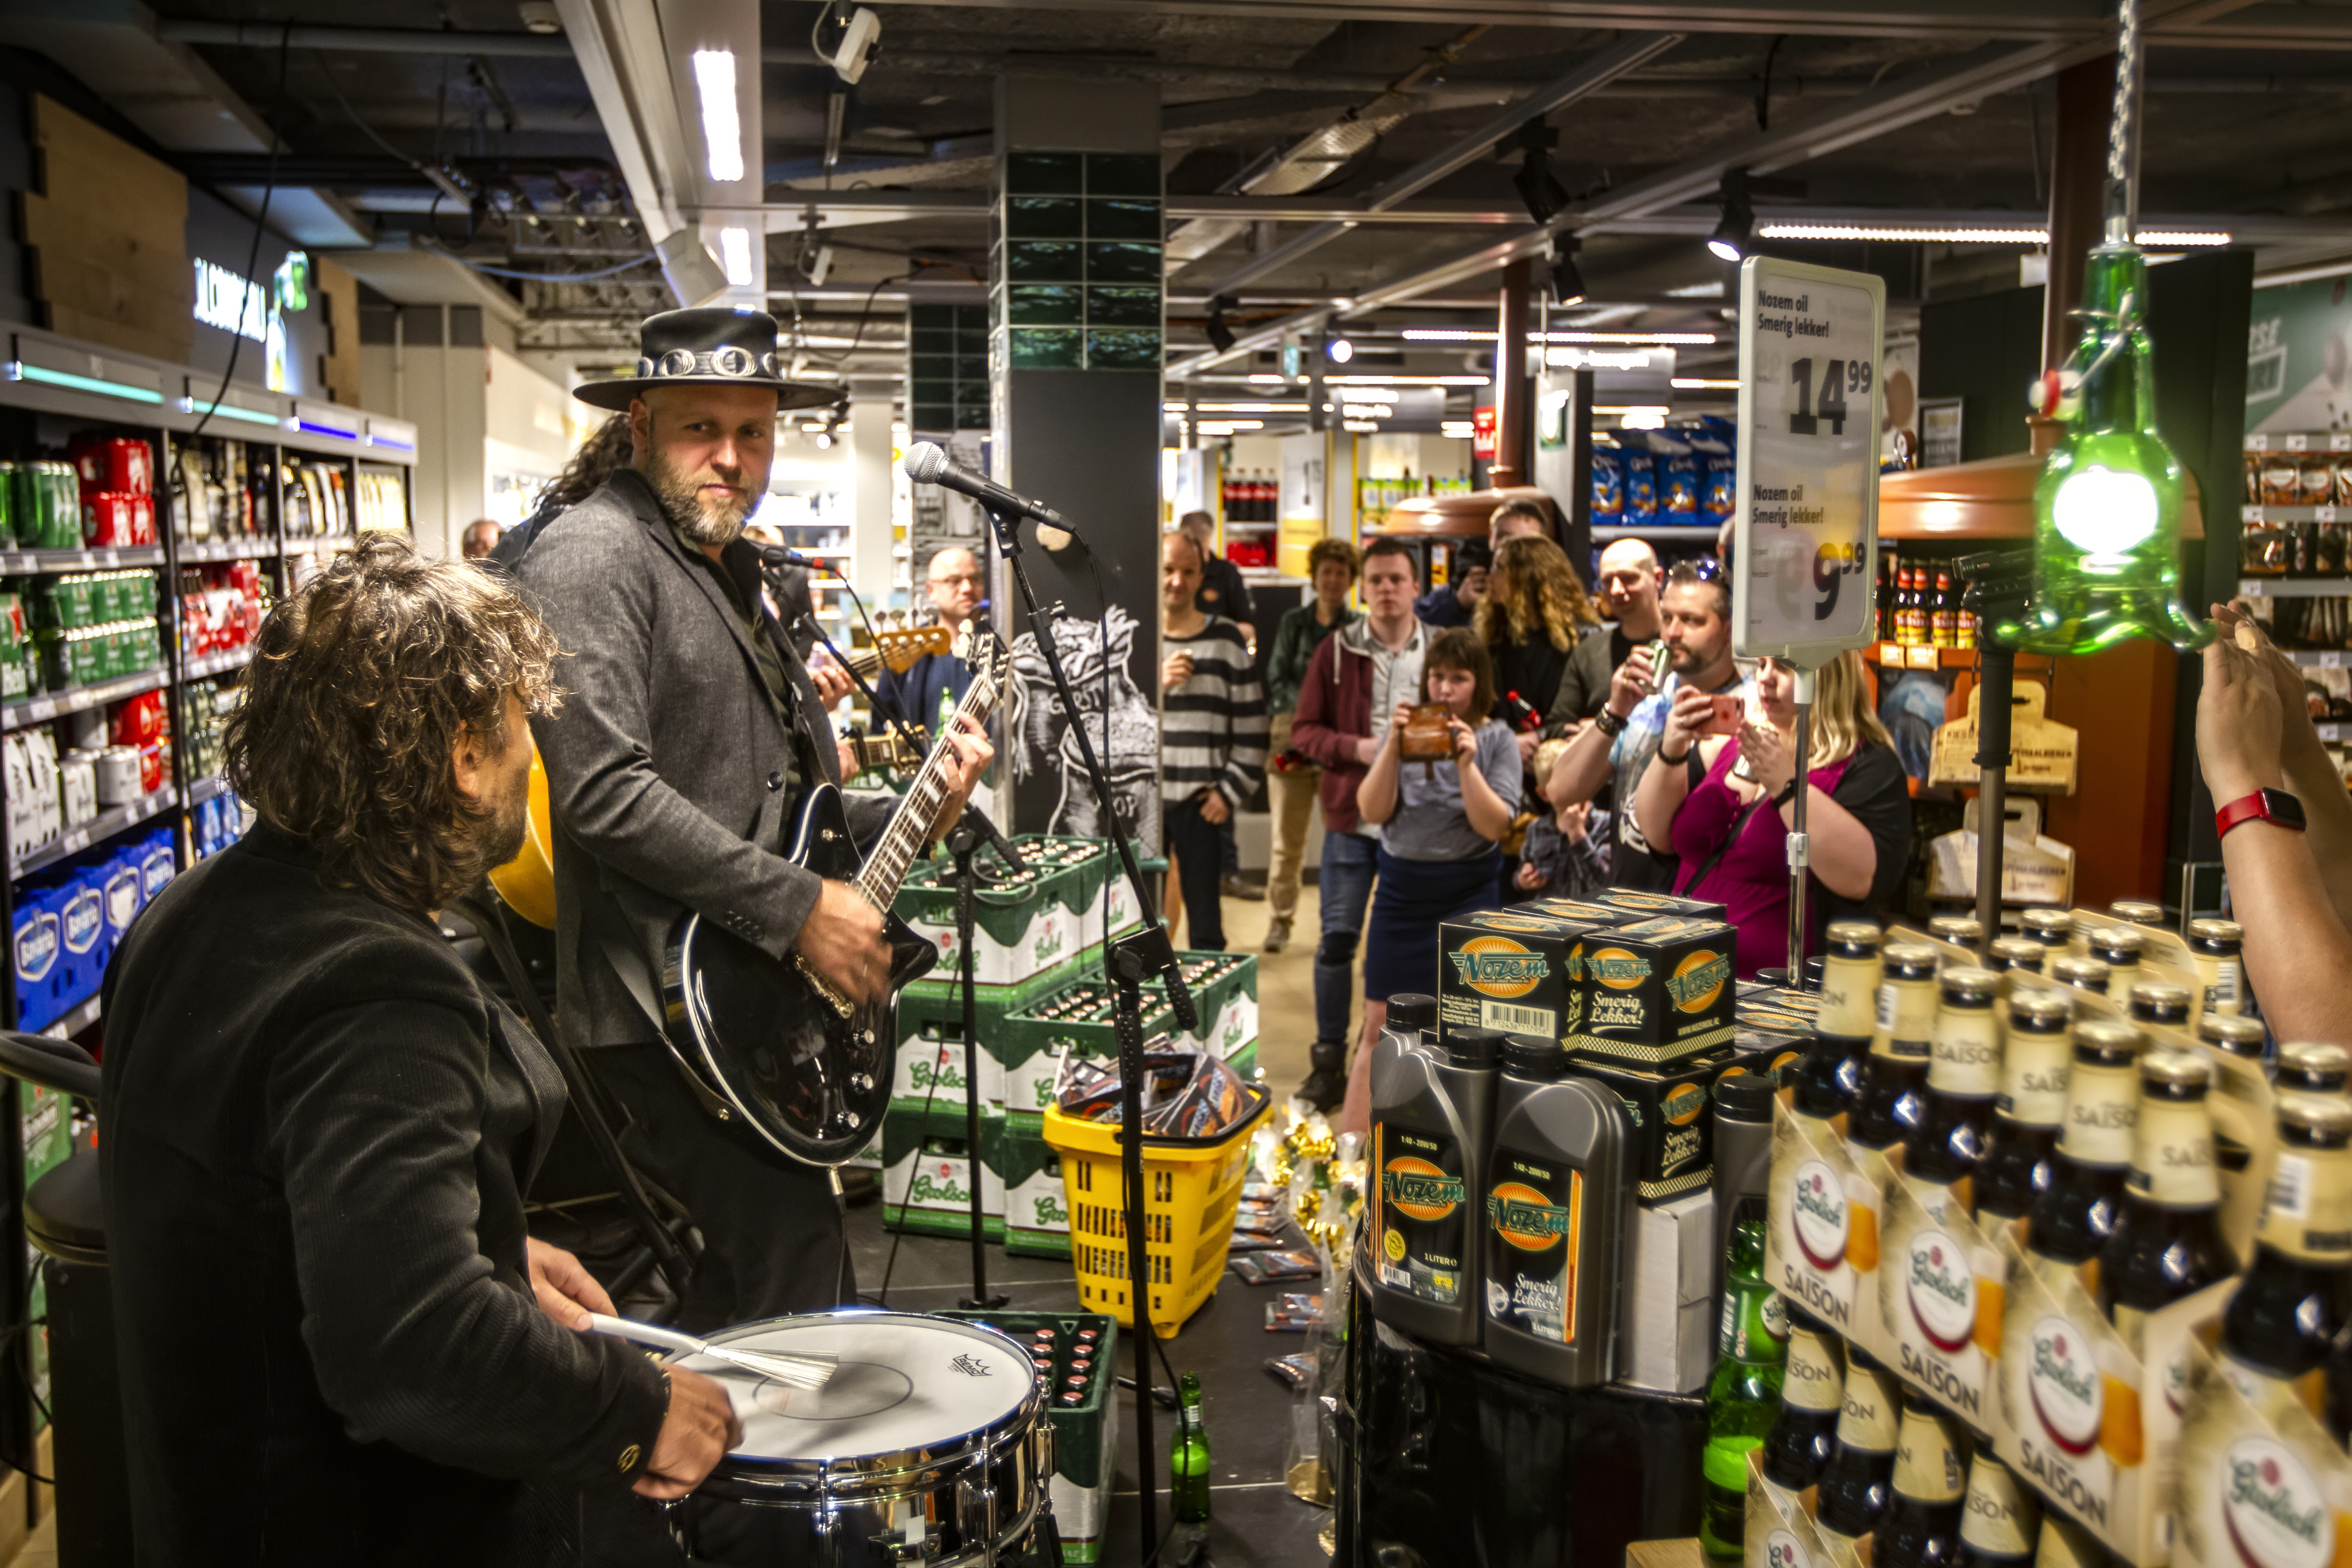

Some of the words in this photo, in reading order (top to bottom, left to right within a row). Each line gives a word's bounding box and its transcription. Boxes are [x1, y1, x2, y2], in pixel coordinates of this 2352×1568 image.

[1758, 289, 1793, 310] Nozem
[1795, 294, 1808, 312] oil
[1758, 313, 1793, 339] Smerig
[1795, 316, 1829, 338] lekker!
[1790, 357, 1847, 435] 14
[1848, 360, 1872, 394] 99
[1753, 485, 1788, 501] Nozem
[1790, 484, 1802, 501] oil
[1752, 506, 1787, 529] Smerig
[1790, 507, 1824, 524] lekker!
[1813, 543, 1841, 620] 9
[1459, 952, 1550, 984] Nozem
[1591, 959, 1652, 980] Nozem
[1593, 991, 1642, 1013] Smerig
[1590, 1006, 1645, 1024] Lekker!
[1385, 1170, 1466, 1203] Nozem
[1490, 1196, 1570, 1234] Nozem
[1429, 1253, 1450, 1266] LITER
[1516, 1273, 1558, 1298] Smerig
[1785, 1264, 1849, 1327] SAISON
[1512, 1288, 1562, 1311] Lekker!
[956, 1358, 981, 1375] REMO
[1900, 1341, 1980, 1415] SAISON
[2021, 1438, 2106, 1530] SAISON
